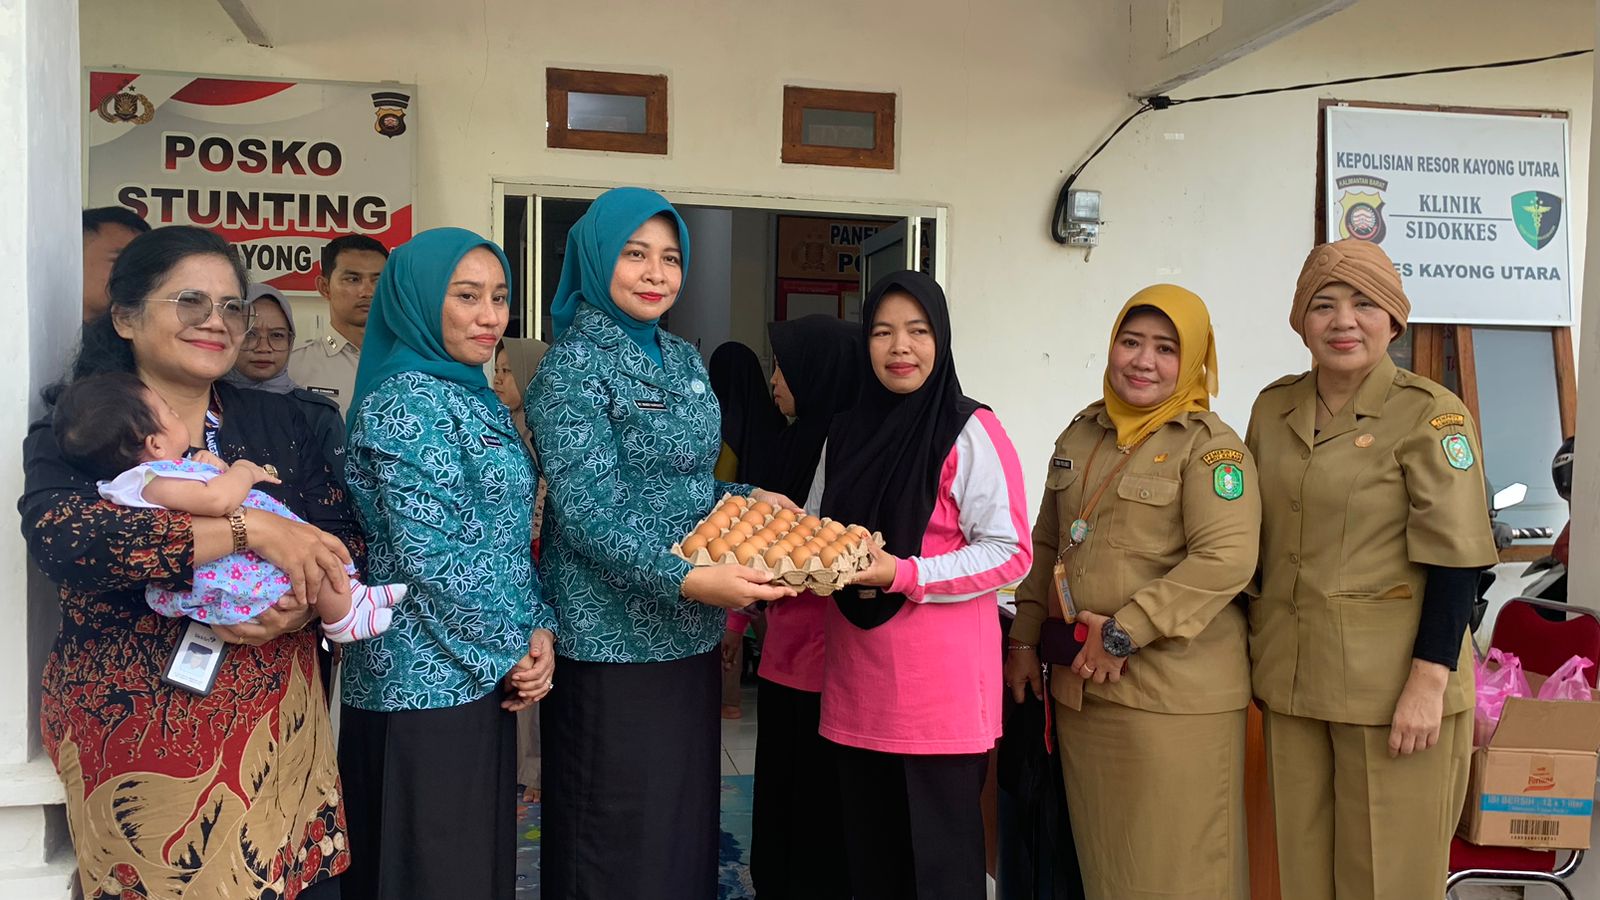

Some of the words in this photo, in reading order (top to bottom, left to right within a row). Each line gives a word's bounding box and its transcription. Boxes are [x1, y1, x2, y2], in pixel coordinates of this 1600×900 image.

[164, 135, 343, 177] POSKO
[1336, 151, 1413, 172] KEPOLISIAN
[1417, 156, 1459, 174] RESOR
[1463, 159, 1514, 176] KAYONG
[1518, 160, 1560, 178] UTARA
[1338, 177, 1369, 187] KALIMANTAN
[1369, 178, 1386, 190] BARAT
[117, 186, 388, 230] STUNTING
[1419, 194, 1482, 215] KLINIK
[1405, 221, 1497, 241] SIDOKKES
[1419, 264, 1495, 279] KAYONG
[1501, 266, 1561, 281] UTARA
